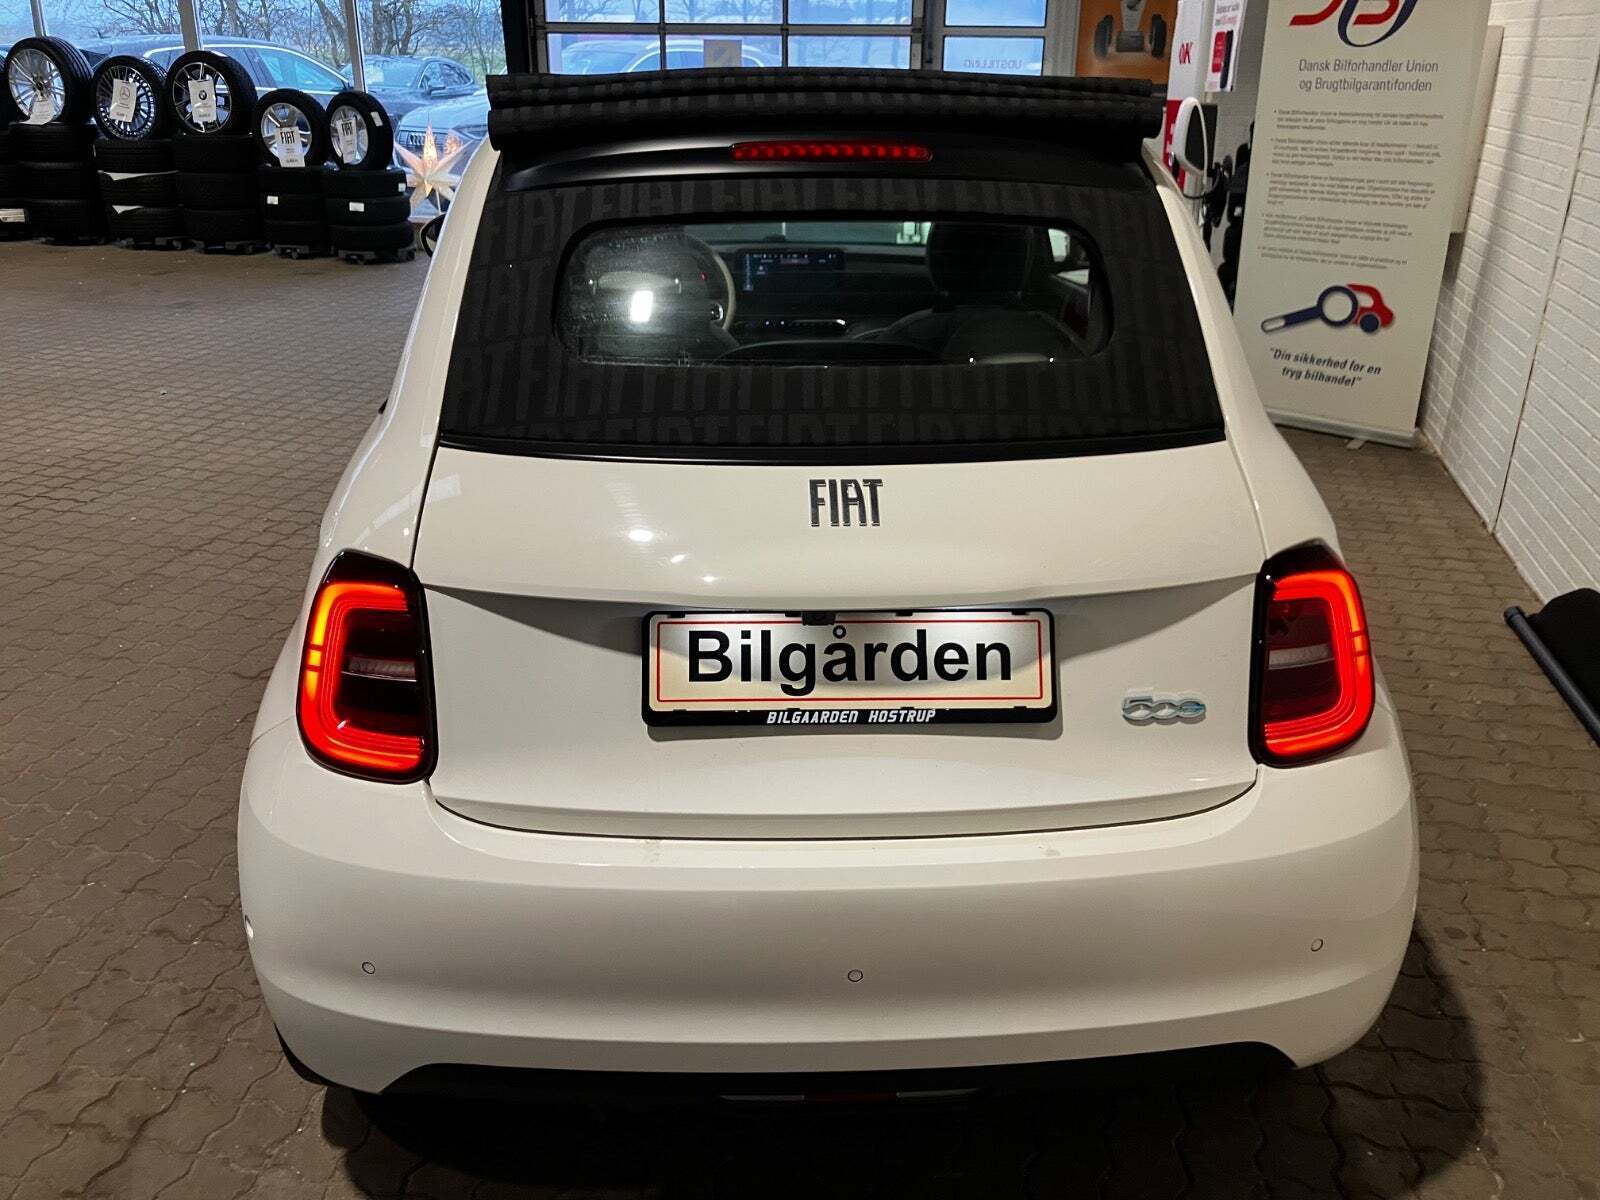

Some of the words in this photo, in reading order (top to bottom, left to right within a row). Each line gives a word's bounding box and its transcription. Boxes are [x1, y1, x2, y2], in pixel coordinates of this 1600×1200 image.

[1298, 58, 1331, 72] Dansk
[1333, 59, 1404, 73] Bilforhandler
[1405, 60, 1439, 73] Union
[1299, 79, 1312, 93] og
[1315, 77, 1432, 93] Brugtbilgarantifonden
[342, 122, 352, 136] FIAT
[280, 131, 295, 144] FIAT
[1293, 351, 1348, 370] sikkerhed
[1366, 365, 1382, 375] en
[1281, 366, 1303, 380] tryg
[808, 478, 883, 527] FIAT
[687, 624, 1012, 697] Bilgården
[1122, 692, 1207, 722] 500
[766, 710, 859, 724] BILGAARDEN
[868, 709, 936, 723] HOSTRUP
